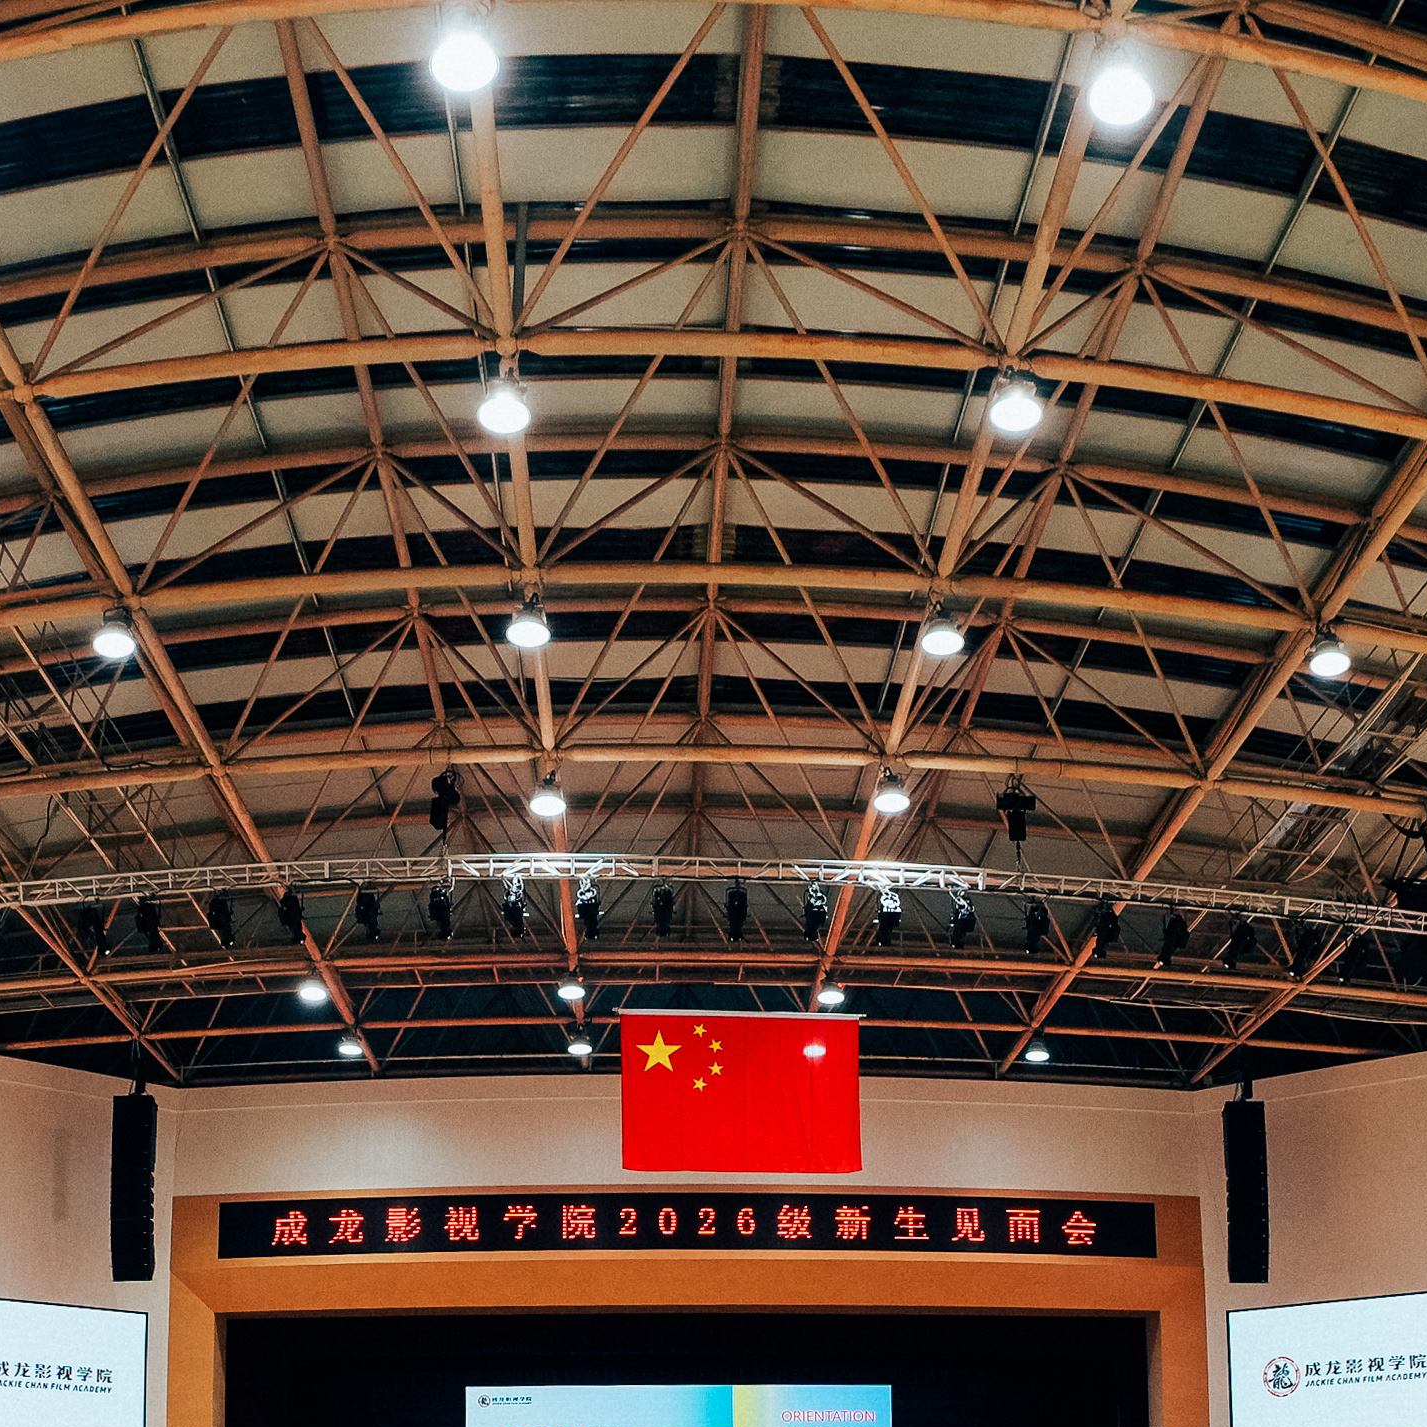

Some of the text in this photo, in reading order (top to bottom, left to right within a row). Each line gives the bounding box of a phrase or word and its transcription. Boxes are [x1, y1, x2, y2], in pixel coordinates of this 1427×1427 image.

[272, 1204, 1098, 1246] 成龙影视学院2026级新生见面会
[1305, 1354, 1427, 1377] 成龙影视学院
[25, 1381, 48, 1390] CHAN
[50, 1383, 70, 1391] FILM
[73, 1385, 112, 1394] ACADEMY
[1305, 1372, 1427, 1388] JACKIE CHAN FILM ACADEMY
[781, 1410, 876, 1422] ORIENTATION
